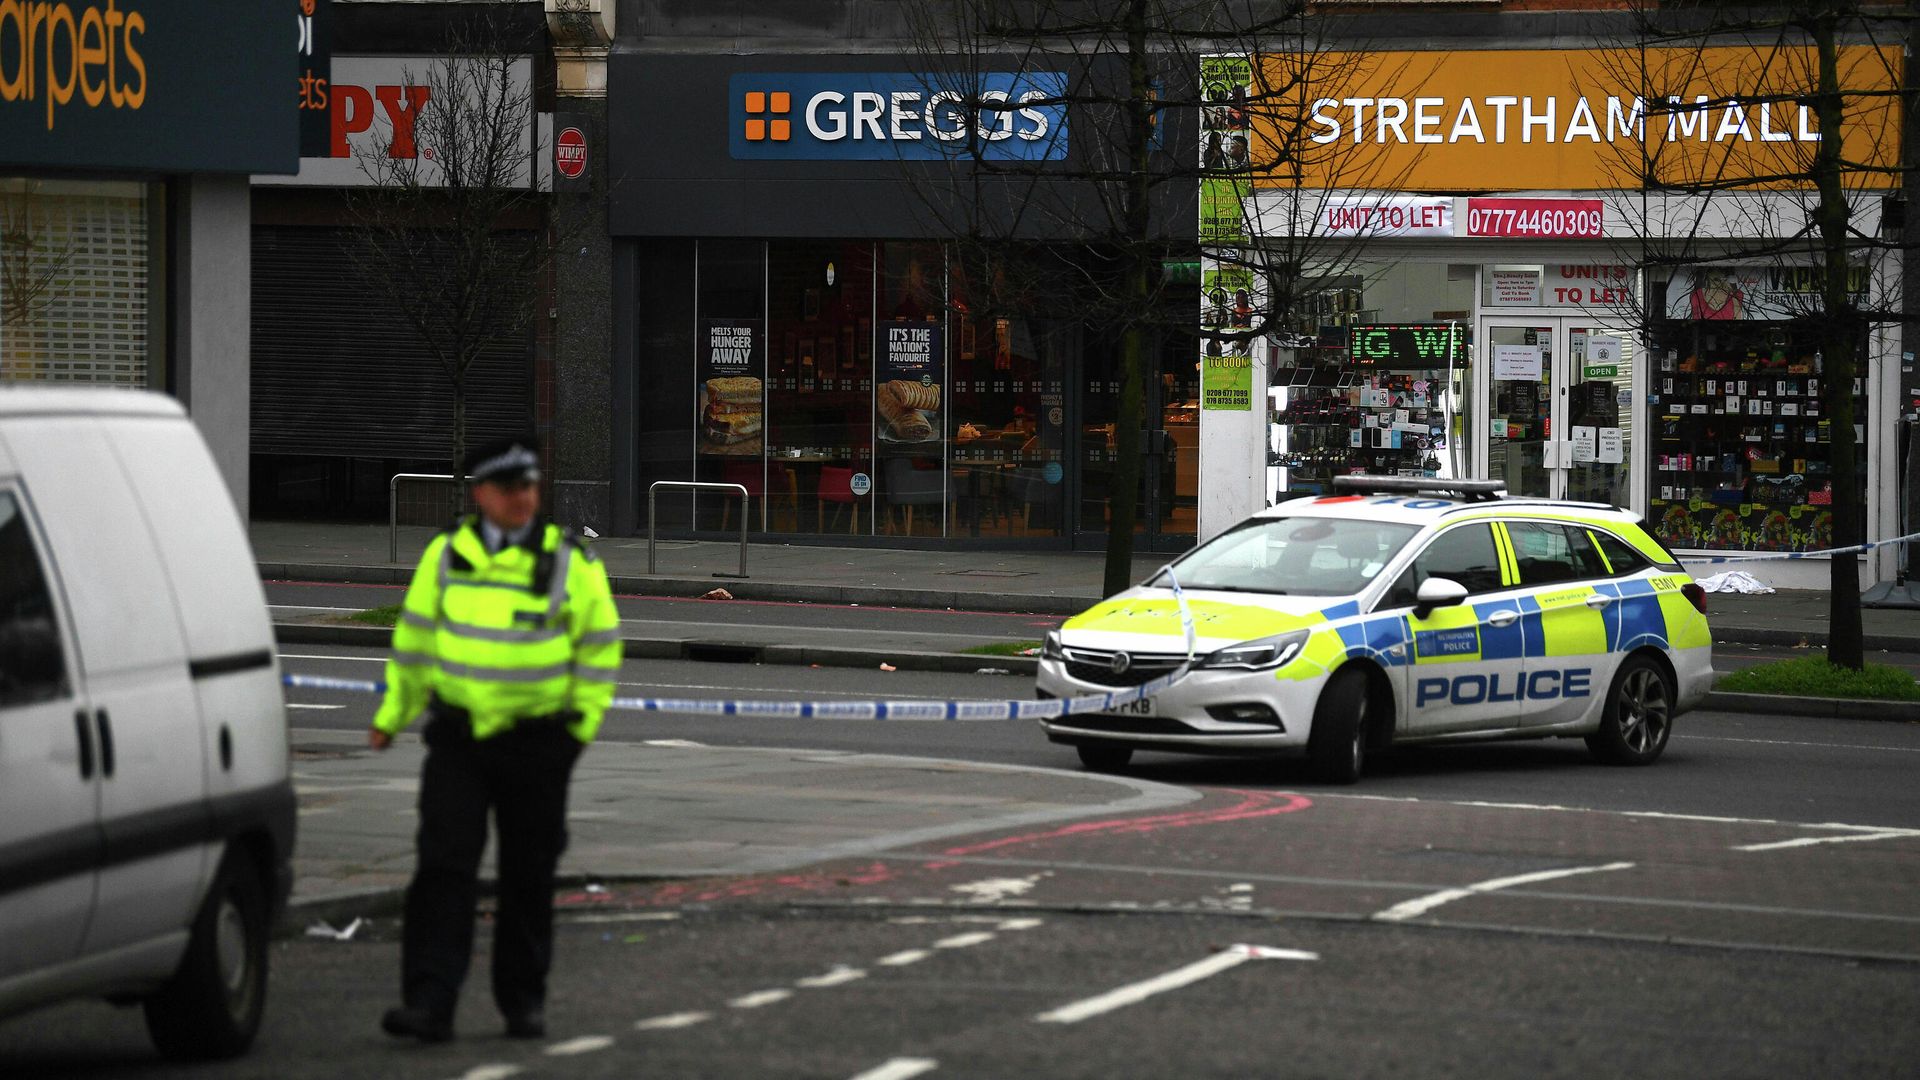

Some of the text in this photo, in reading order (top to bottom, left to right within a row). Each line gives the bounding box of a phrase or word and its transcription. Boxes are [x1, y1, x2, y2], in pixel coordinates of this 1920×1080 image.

[805, 90, 1050, 142] GREGGS
[1310, 95, 1822, 145] STREATHAM MALL
[557, 146, 586, 160] WIMPY
[1328, 205, 1447, 230] UNIT TO LET
[1469, 208, 1602, 236] 07774460309
[1561, 265, 1627, 279] UNITS
[1554, 287, 1629, 304] TO LET
[711, 327, 751, 336] MELTS YOUR
[889, 328, 930, 341] IT'S THE
[711, 336, 751, 348] HUNGER
[889, 342, 930, 353] NATION'S
[711, 348, 751, 364] AWAY
[889, 353, 930, 362] FAVOURITE
[1589, 367, 1611, 376] OPEN
[1652, 577, 1677, 591] EMV
[1443, 641, 1471, 651] POLICE
[1415, 668, 1592, 708] POLICE
